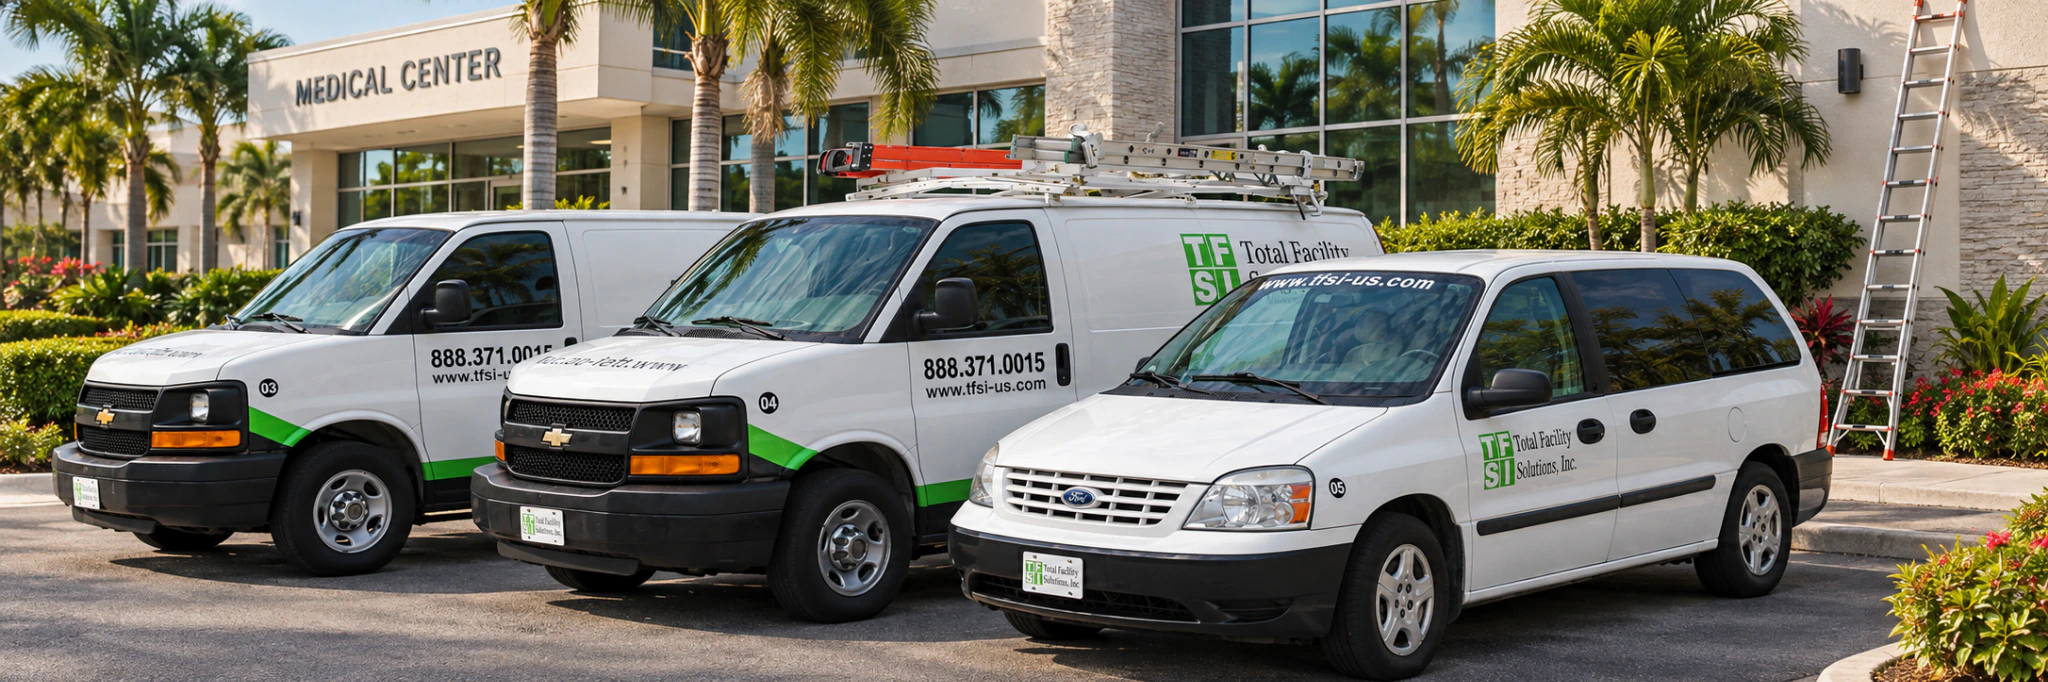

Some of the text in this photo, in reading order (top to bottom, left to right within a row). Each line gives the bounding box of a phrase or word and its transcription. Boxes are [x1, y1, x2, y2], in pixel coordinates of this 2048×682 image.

[296, 47, 502, 106] MEDICAL CENTER
[1239, 240, 1290, 265] Total
[1257, 272, 1436, 291] www.tfsi-us.com
[924, 352, 1046, 380] 888.371.0015
[261, 382, 277, 395] 03
[926, 379, 1046, 398] www.tfsi-us.com
[760, 395, 777, 410] 04
[1512, 429, 1571, 452] Total Facility
[1516, 455, 1578, 480] Solutions, Inc.
[1330, 481, 1345, 495] 05
